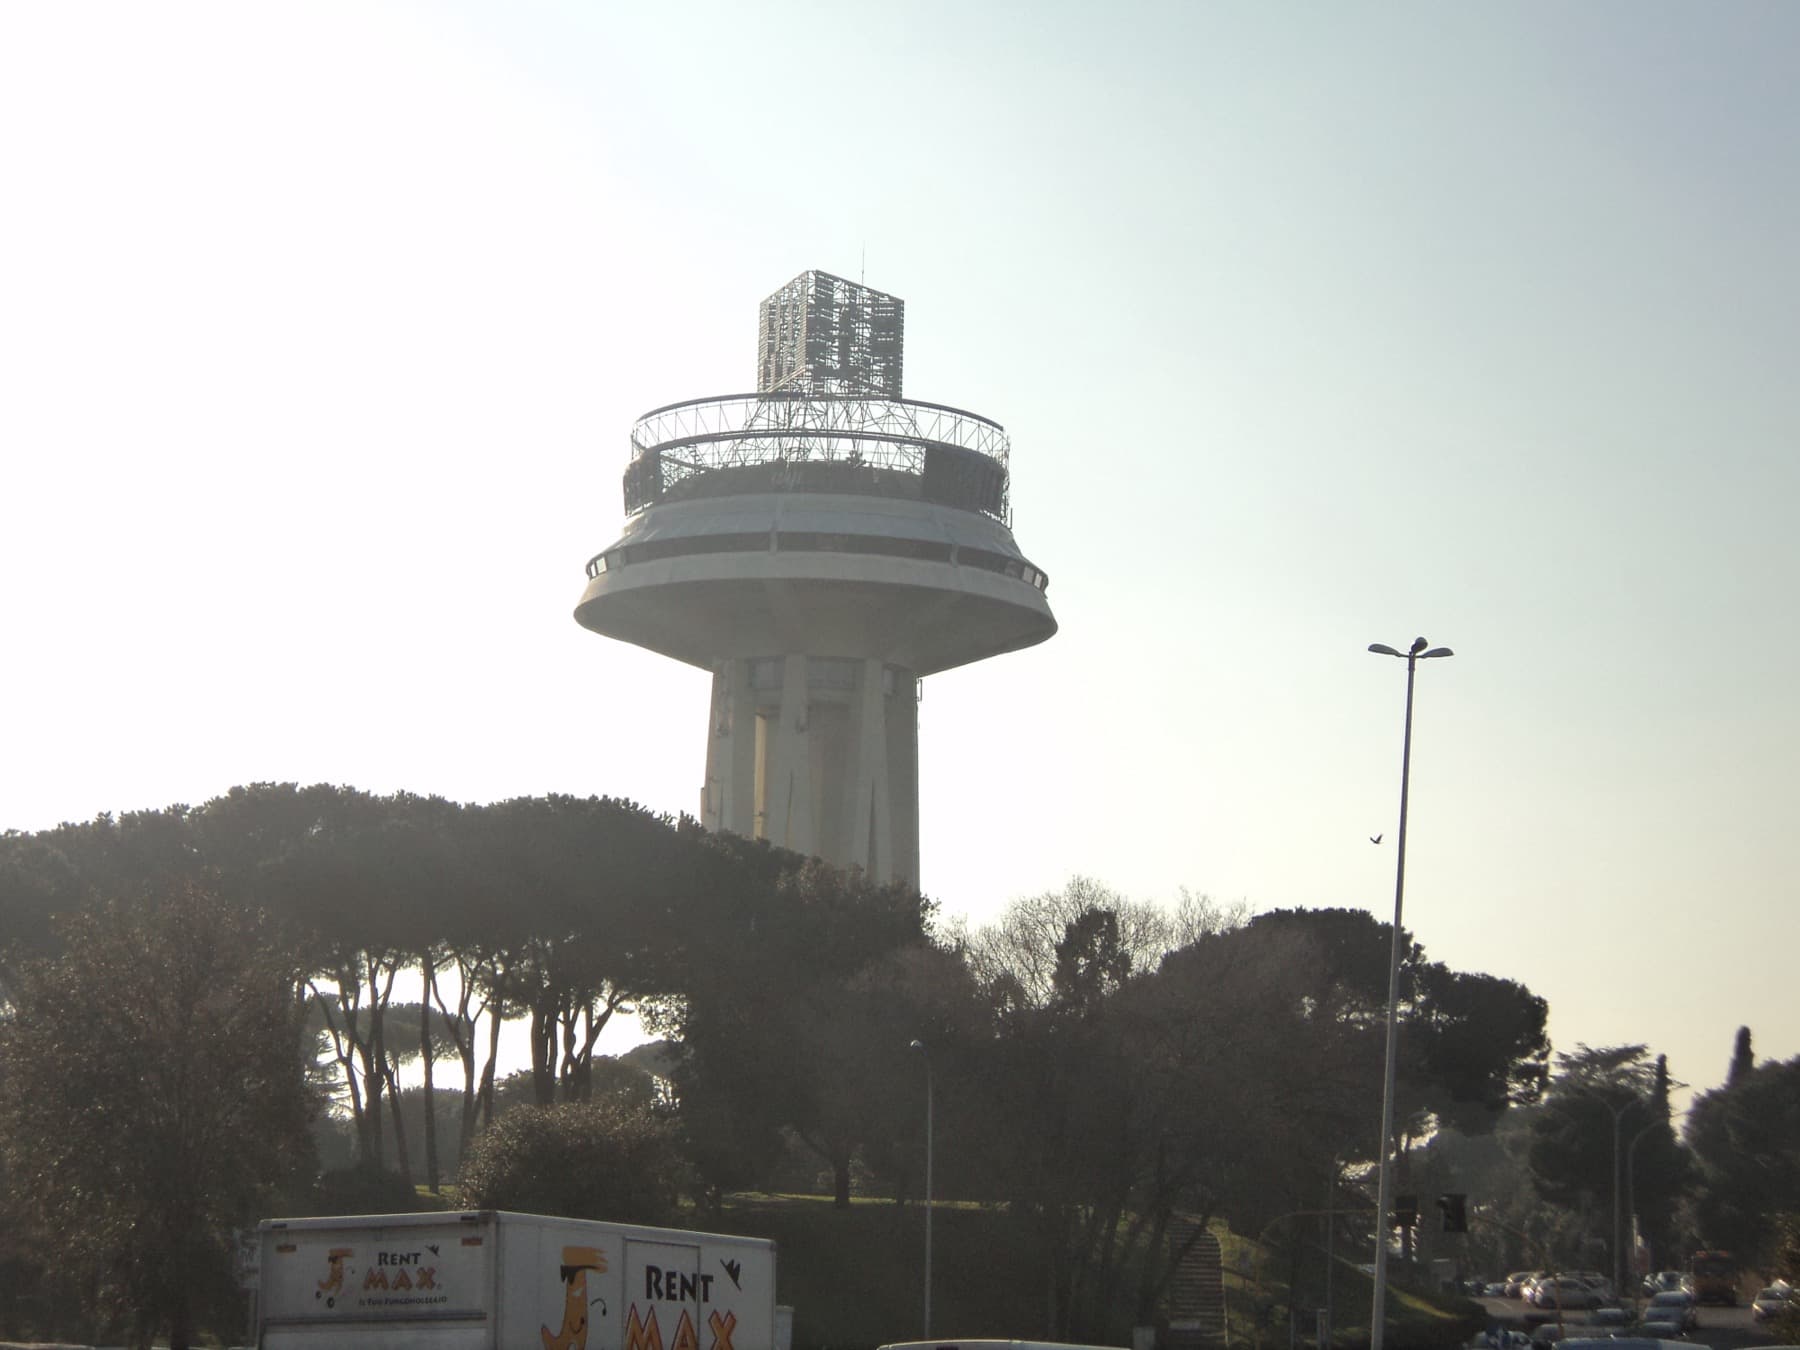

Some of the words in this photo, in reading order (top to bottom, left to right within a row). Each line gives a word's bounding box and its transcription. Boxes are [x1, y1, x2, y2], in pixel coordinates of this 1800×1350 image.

[378, 1252, 421, 1266] RENT
[364, 1266, 436, 1290] MAX
[645, 1264, 714, 1303] RENT
[623, 1301, 737, 1350] MAX
